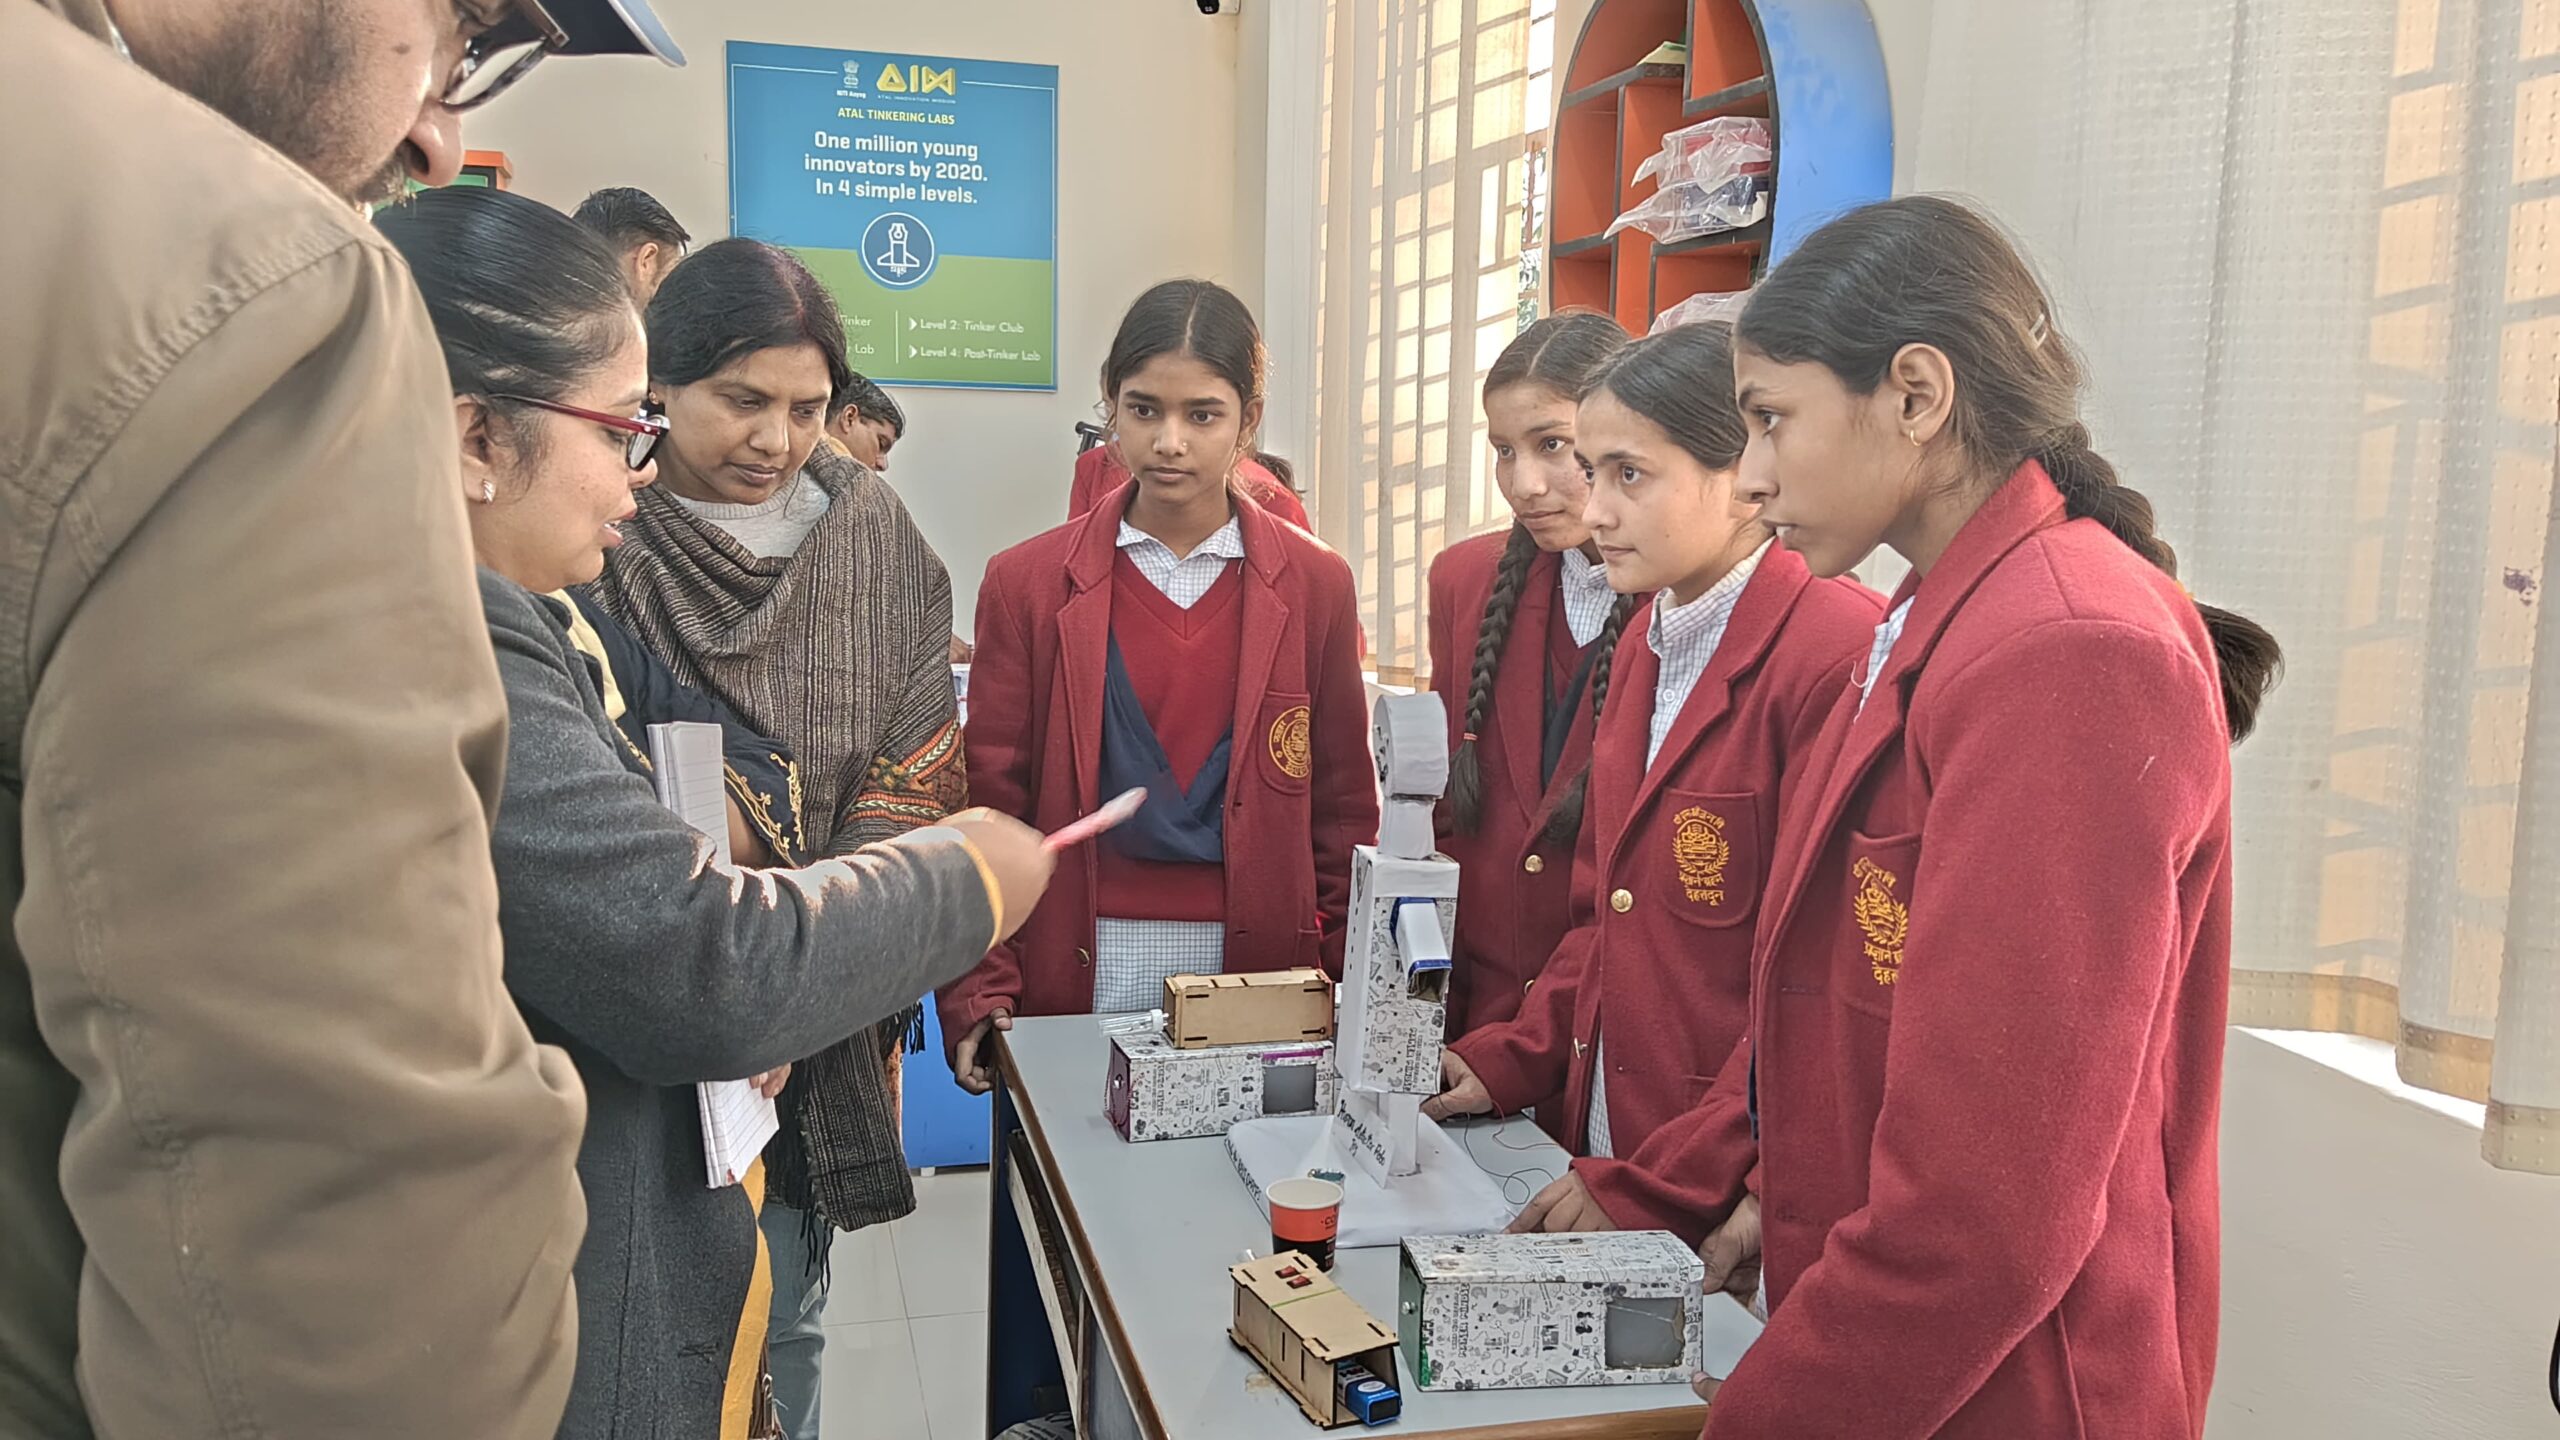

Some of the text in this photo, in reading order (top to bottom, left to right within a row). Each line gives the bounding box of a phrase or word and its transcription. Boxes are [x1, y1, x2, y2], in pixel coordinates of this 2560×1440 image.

[837, 107, 956, 126] ATAL TINKERING LABS
[814, 130, 978, 161] One million young
[804, 153, 989, 182] innovators by 2020.
[815, 178, 978, 204] In 4 simple levels.
[920, 318, 1025, 333] Level 2: Tinker Club
[855, 343, 875, 355] Lab
[920, 346, 1041, 362] Level 4: Post-Tinker Lab
